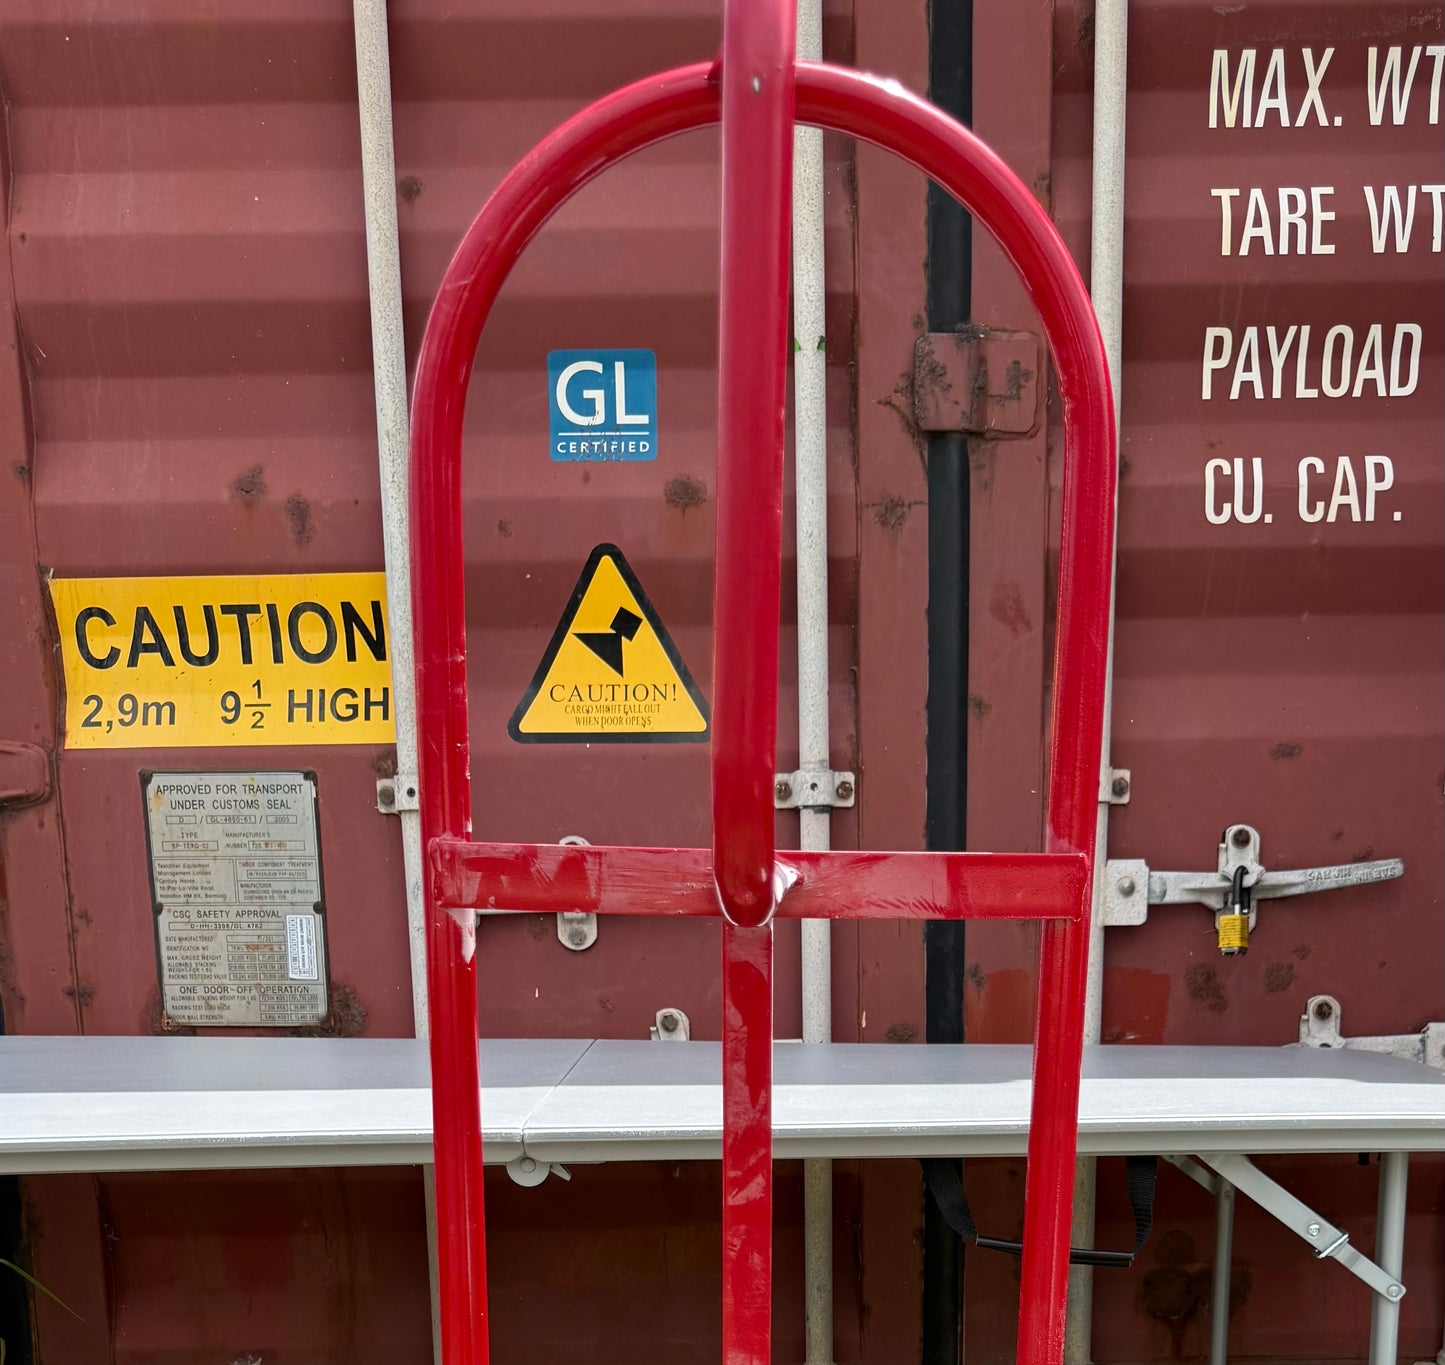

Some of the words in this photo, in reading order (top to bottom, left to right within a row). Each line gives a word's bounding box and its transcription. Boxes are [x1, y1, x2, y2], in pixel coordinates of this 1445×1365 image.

[1208, 47, 1343, 128] MAX.
[1210, 186, 1336, 256] TARE
[1202, 323, 1422, 400] PAYLOAD
[556, 361, 649, 426] GL
[557, 441, 650, 454] CERTIFIED
[1205, 457, 1273, 524] CU.
[1298, 455, 1402, 523] CAP.
[75, 600, 387, 670] CAUTION
[550, 683, 677, 702] CAUTION!
[81, 693, 176, 734] 2,9m
[287, 687, 389, 723] HIGH
[564, 705, 594, 714] CARGO
[595, 704, 622, 714] MIGHT
[623, 704, 643, 715] FALL
[644, 704, 661, 713] OUT
[575, 717, 600, 726] WHEN
[600, 716, 626, 727] DOOR
[625, 716, 652, 727] OPENS
[156, 784, 211, 795] APPROVED
[216, 784, 237, 795] FOR
[242, 783, 303, 794] TRANSPORT
[170, 800, 205, 810] UNDER
[212, 799, 260, 810] CUSTOMS
[267, 799, 291, 810] SEAL
[172, 910, 191, 918] CSC
[196, 910, 230, 918] SAFETY
[236, 910, 282, 918] APPROVAL
[180, 986, 198, 994] ONE
[260, 985, 310, 994] OPERATION
